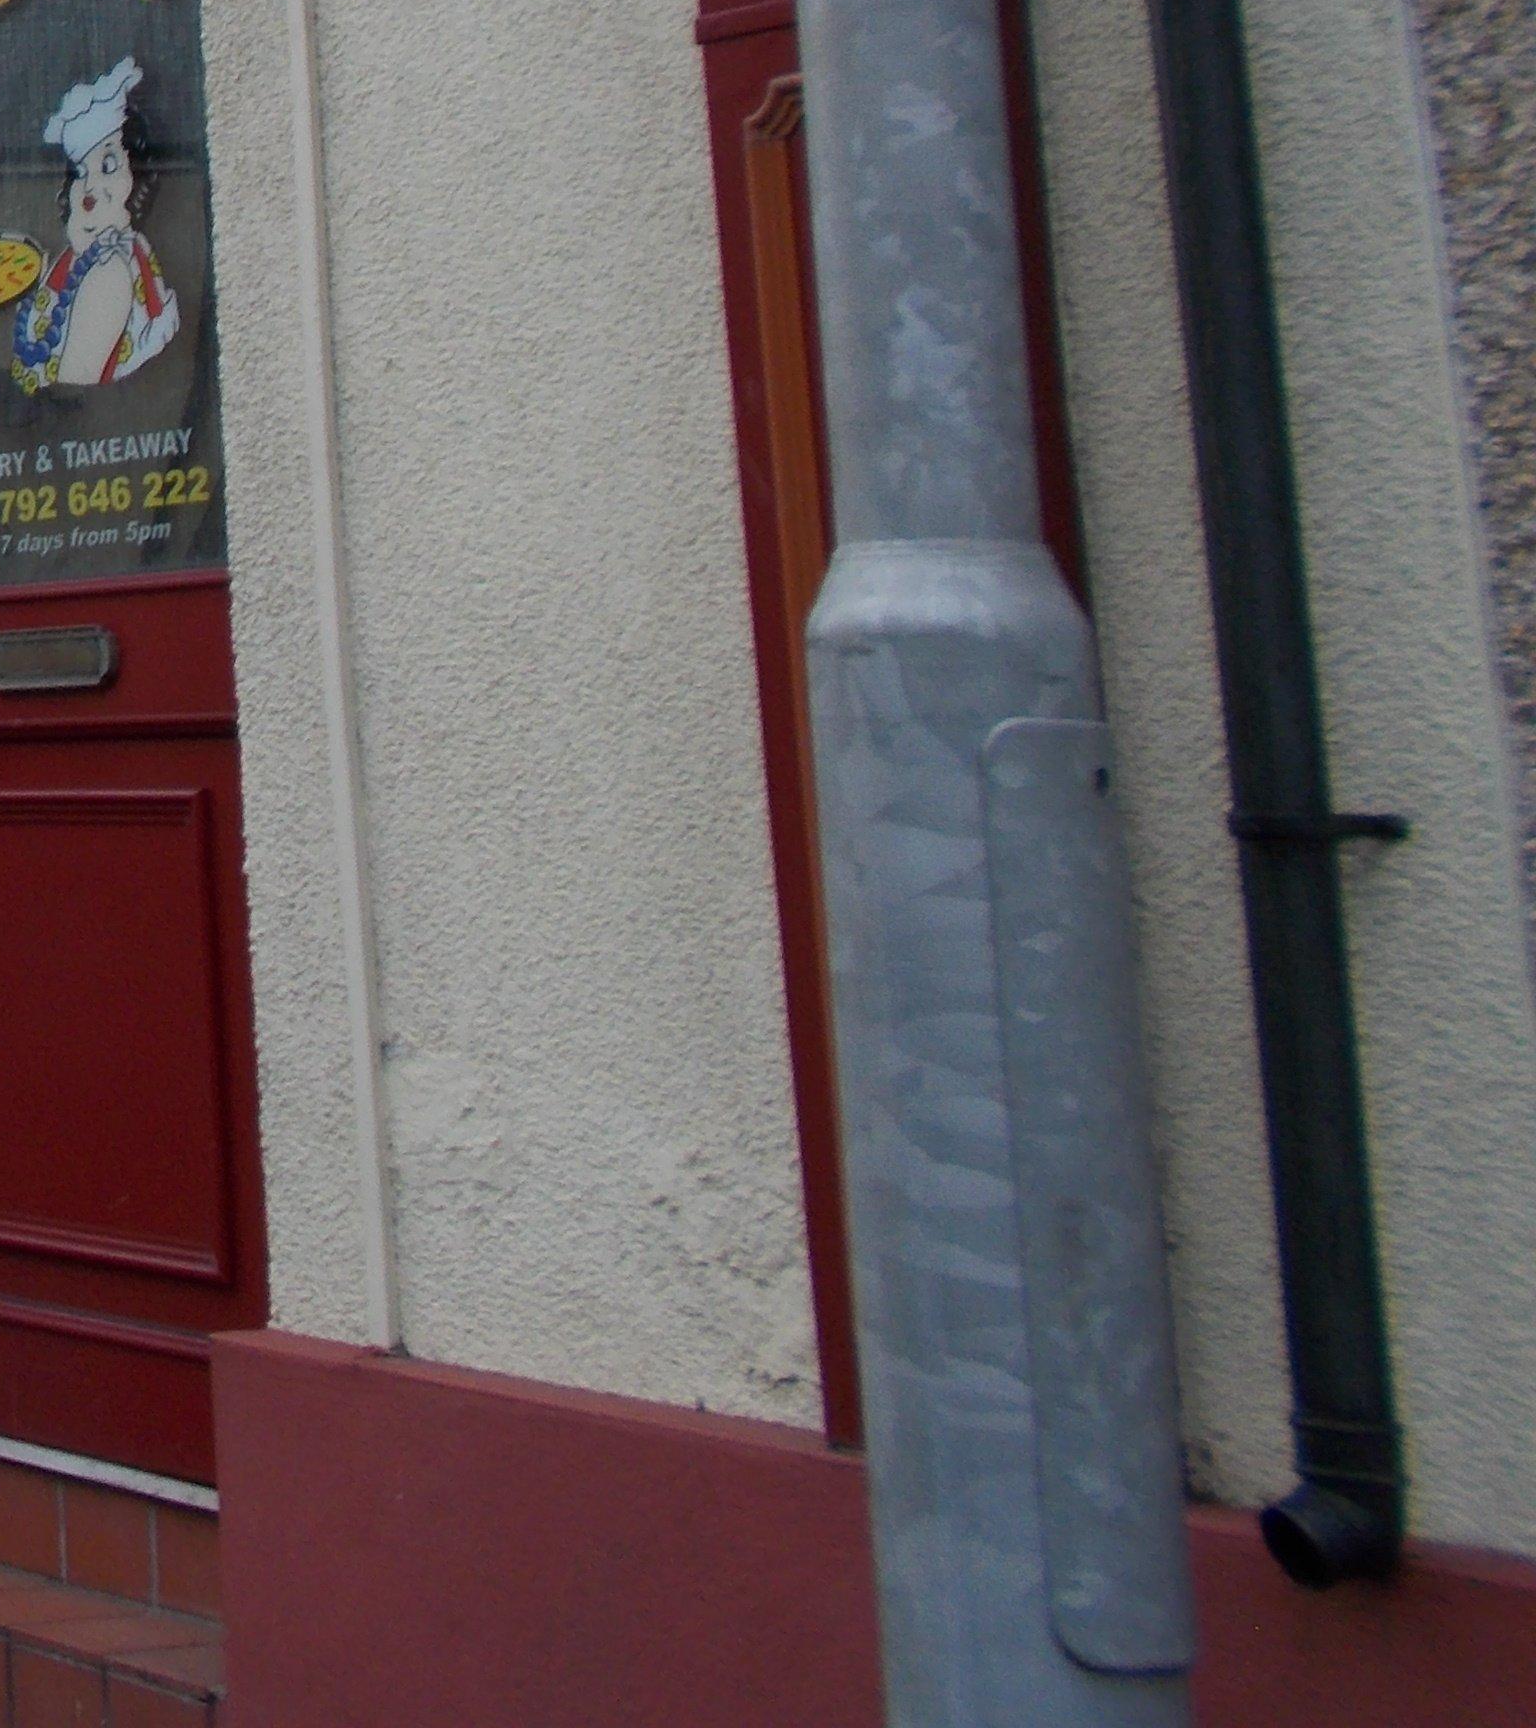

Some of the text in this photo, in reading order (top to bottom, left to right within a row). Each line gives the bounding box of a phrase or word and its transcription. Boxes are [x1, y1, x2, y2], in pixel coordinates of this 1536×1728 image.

[35, 445, 53, 474] &
[60, 427, 194, 470] TAKEAWAY
[68, 476, 132, 517] 646
[142, 465, 211, 509] 222
[0, 535, 14, 554] 7
[17, 529, 64, 559] days
[70, 525, 118, 548] from
[125, 521, 172, 547] 5pm
